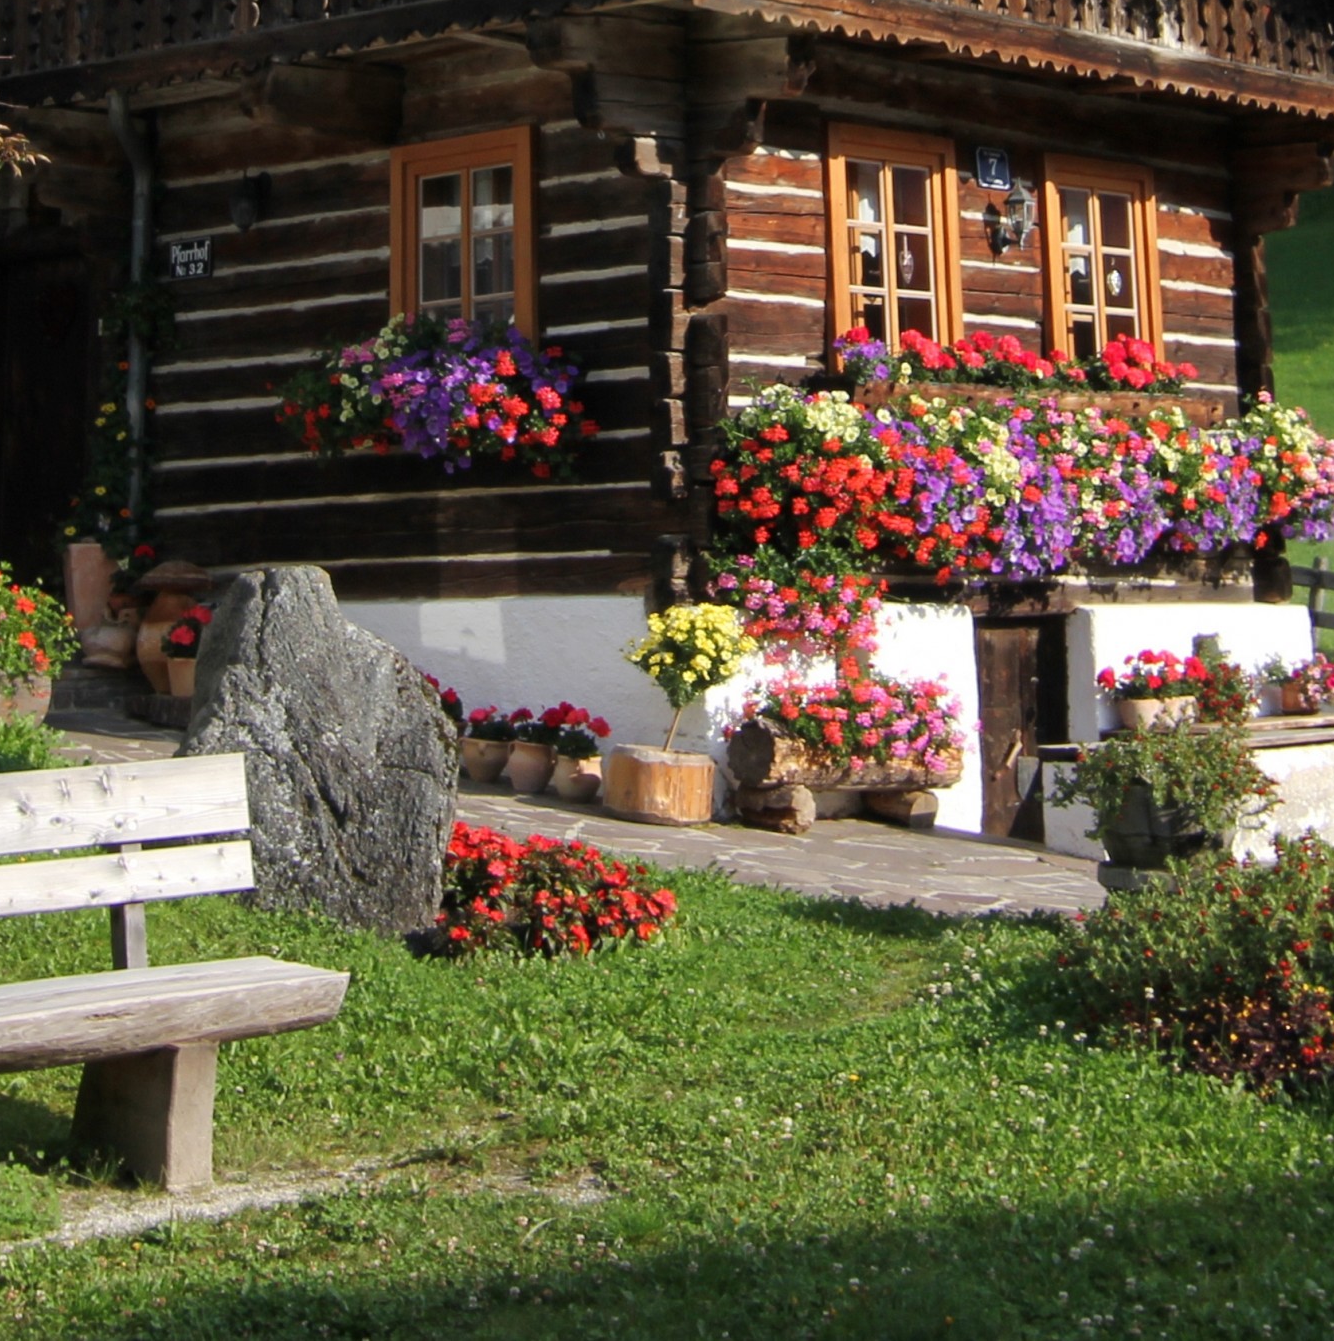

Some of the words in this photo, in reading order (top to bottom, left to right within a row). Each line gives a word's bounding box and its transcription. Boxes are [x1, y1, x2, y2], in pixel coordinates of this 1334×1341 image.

[988, 158, 998, 176] 7
[171, 240, 210, 264] Pfarrhof
[188, 262, 204, 275] 32
